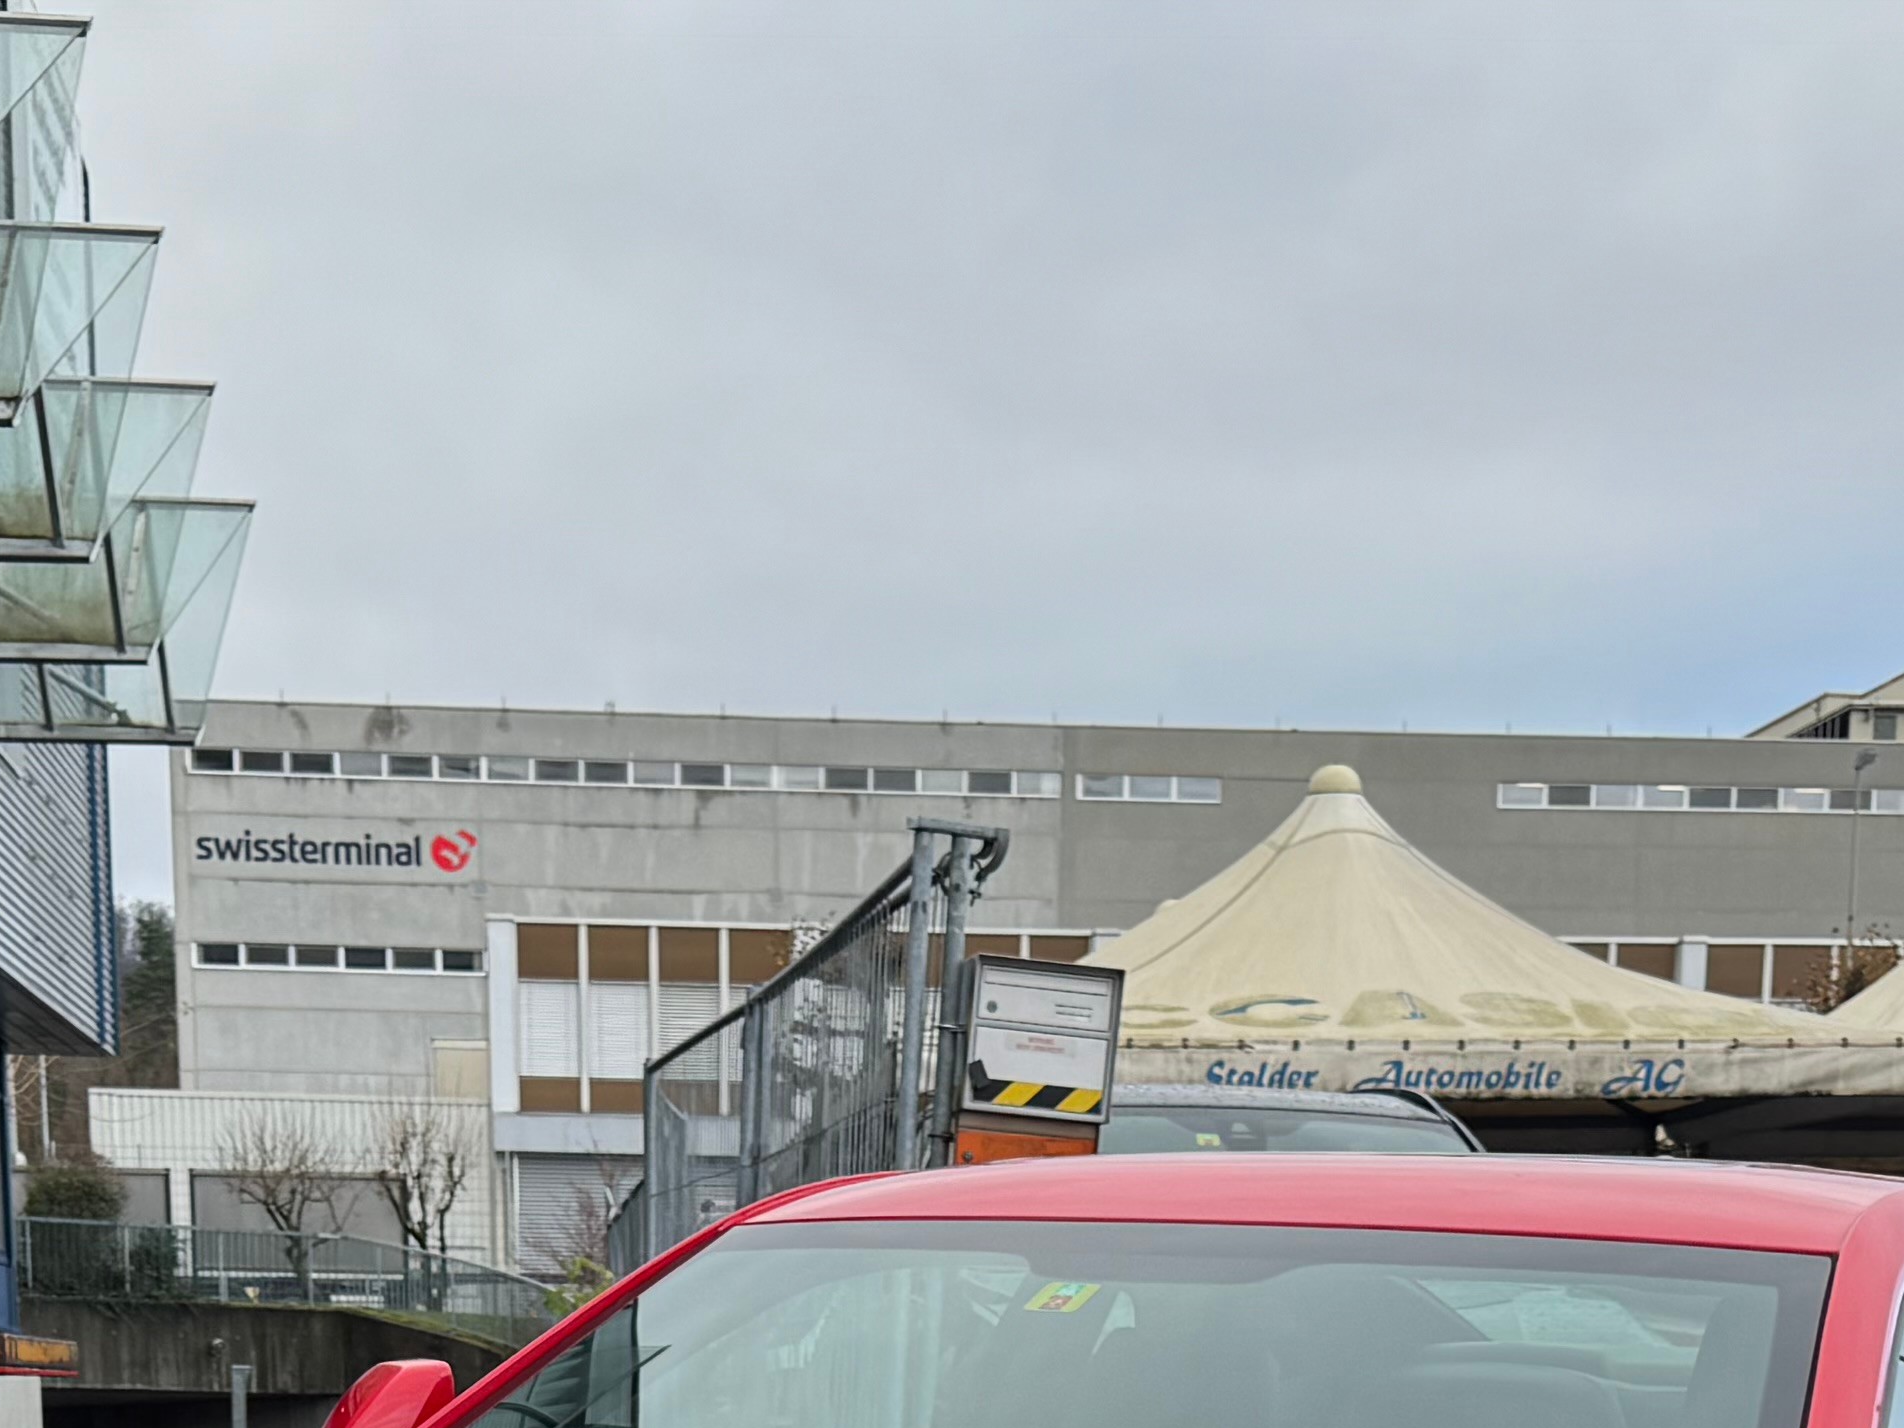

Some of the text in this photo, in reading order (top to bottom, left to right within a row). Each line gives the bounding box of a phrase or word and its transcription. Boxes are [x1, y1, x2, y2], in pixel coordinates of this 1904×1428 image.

[195, 828, 423, 868] swissterminal
[1206, 1058, 1686, 1096] Stalder Automobile AG
